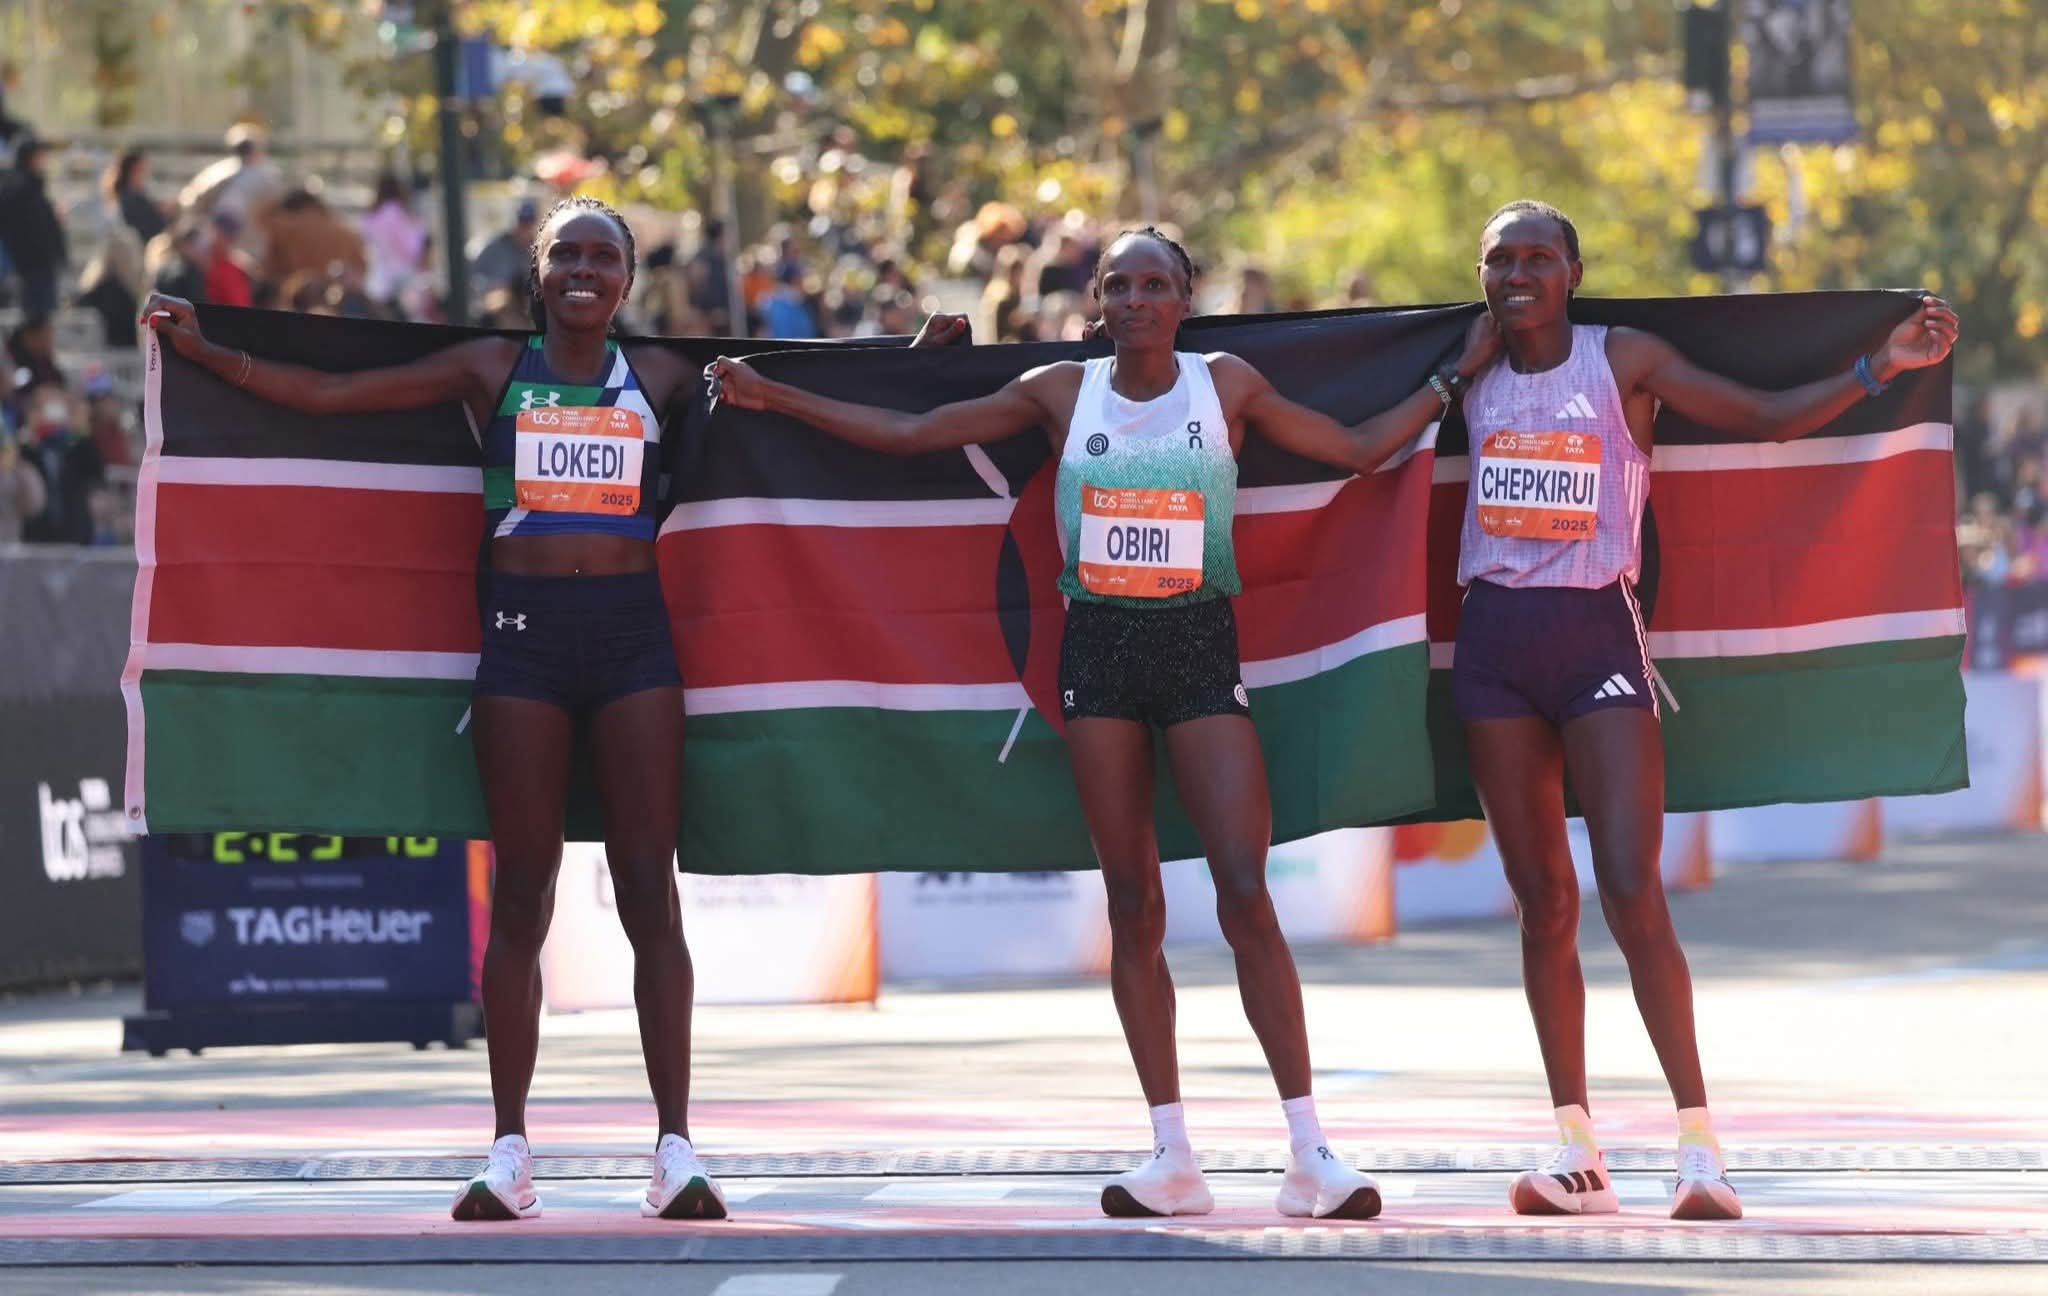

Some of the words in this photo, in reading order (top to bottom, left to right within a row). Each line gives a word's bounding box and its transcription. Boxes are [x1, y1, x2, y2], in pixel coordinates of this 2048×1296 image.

[533, 410, 560, 425] tcs
[610, 421, 629, 430] TATA
[1494, 433, 1517, 450] tcs
[1565, 447, 1584, 455] TATA
[537, 441, 625, 481] LOKEDI
[1481, 466, 1596, 506] CHEPKIRUI
[601, 493, 634, 506] 2025
[1093, 490, 1118, 509] tcs
[1168, 504, 1188, 512] TATA
[1551, 518, 1589, 532] 2025
[1106, 525, 1170, 563] OBIRI
[1157, 576, 1195, 590] 2025
